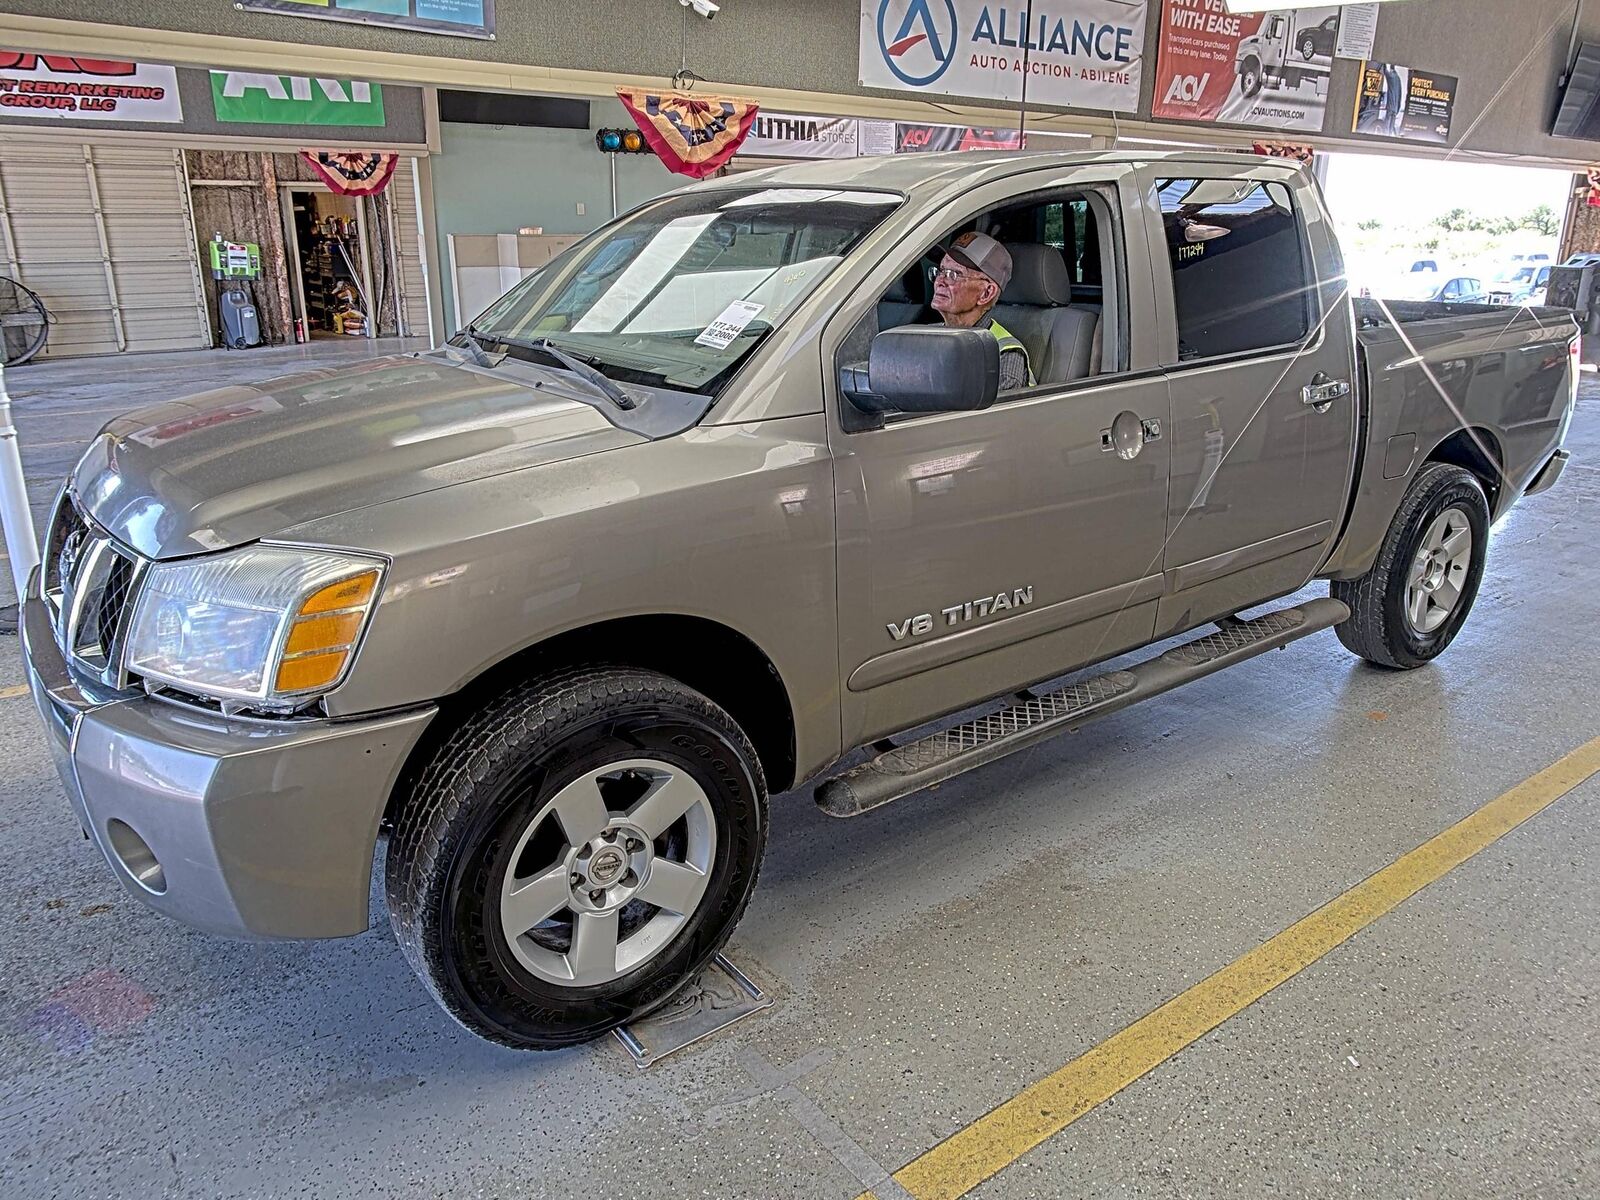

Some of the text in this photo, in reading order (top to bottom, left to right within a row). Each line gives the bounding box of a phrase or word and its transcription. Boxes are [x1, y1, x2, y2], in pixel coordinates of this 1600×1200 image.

[1171, 8, 1241, 37] WITH EASE.
[971, 5, 1132, 62] ALLIANCE
[1169, 33, 1192, 45] Transport
[1204, 41, 1230, 51] purchased
[1173, 46, 1183, 55] this
[1190, 50, 1199, 59] any
[970, 54, 1007, 70] AUTO
[1013, 59, 1071, 78] AUCTION
[1081, 69, 1129, 84] ABILENE
[19, 80, 165, 100] REMARKETING
[1163, 72, 1210, 104] ACV
[1411, 87, 1426, 97] EVERY
[1412, 77, 1433, 88] PROTECT
[1, 93, 116, 112] GROUP, LLC
[1252, 107, 1305, 120] CVAUCTIONS.COM
[757, 117, 844, 141] LITHIA AUTO
[821, 133, 855, 143] STORES
[1179, 242, 1204, 261] 177244
[713, 321, 741, 333] 177,244
[715, 331, 735, 340] 2006
[886, 585, 1033, 641] V8 TITAN
